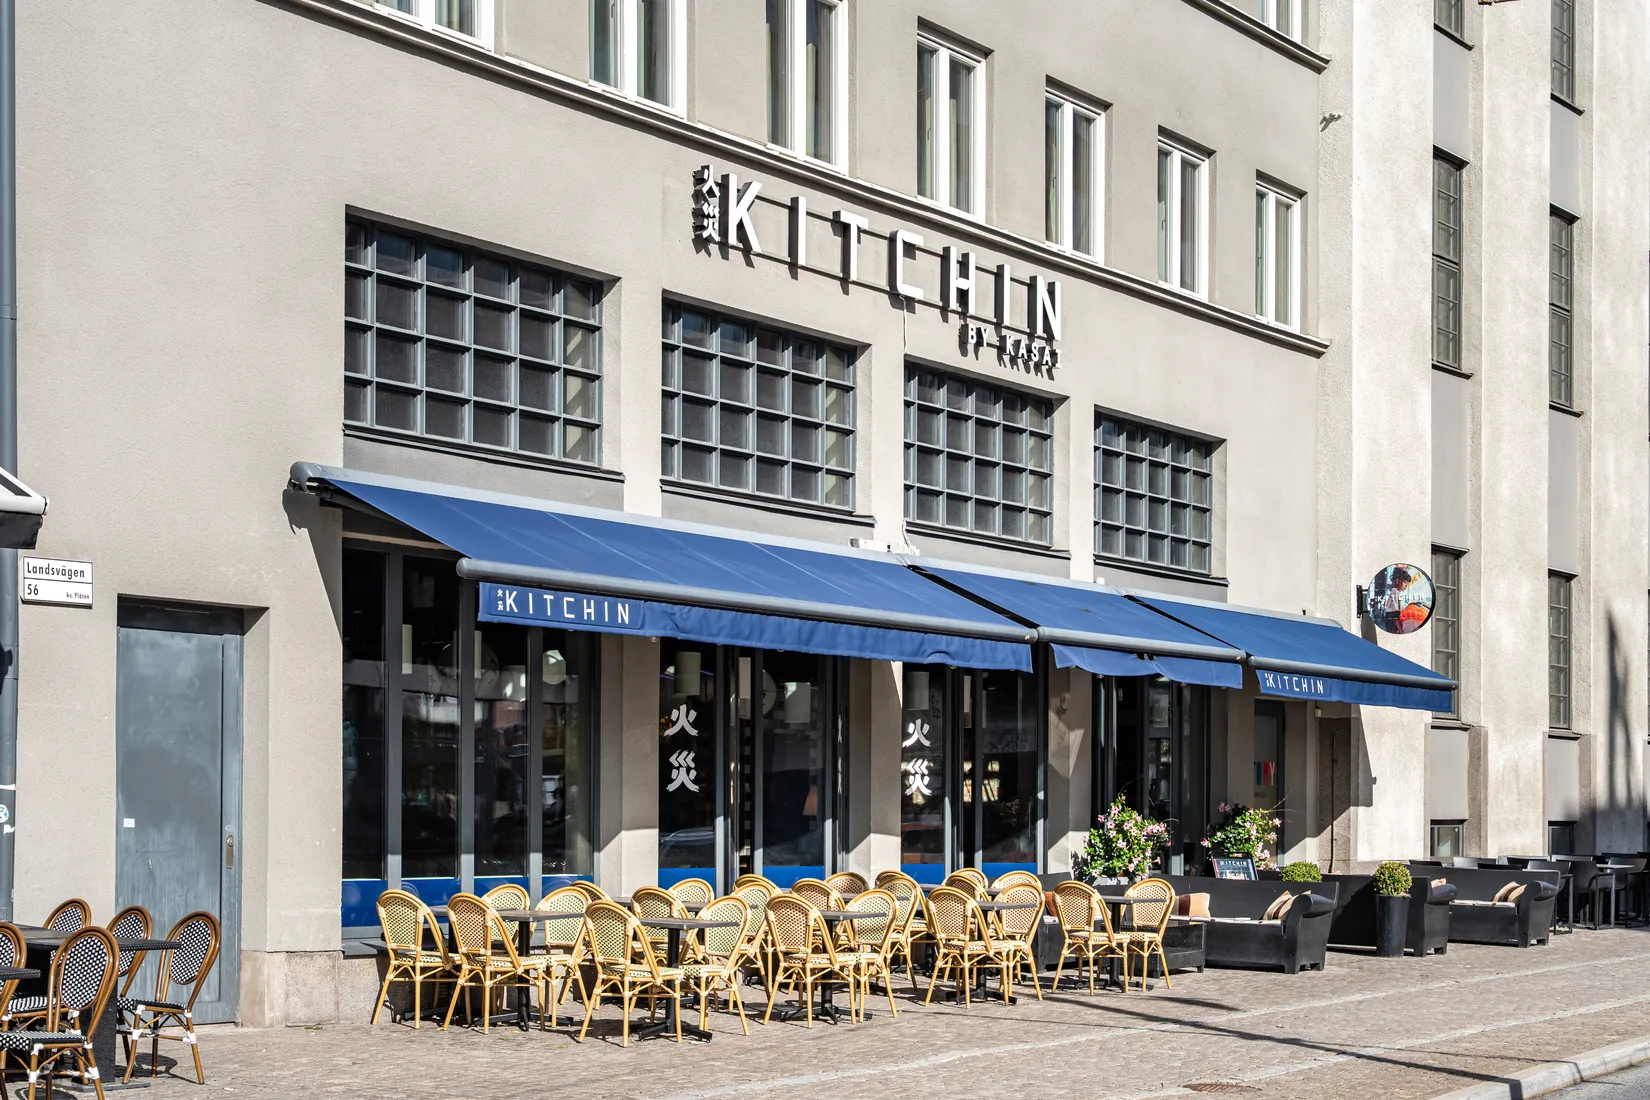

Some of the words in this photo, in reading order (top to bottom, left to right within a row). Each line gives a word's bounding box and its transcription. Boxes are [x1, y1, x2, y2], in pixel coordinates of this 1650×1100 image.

[723, 172, 1061, 341] KITCHIN
[965, 323, 989, 347] BY
[1003, 334, 1062, 369] KASAI
[27, 562, 85, 580] Landsvägen
[27, 583, 39, 596] 56
[505, 590, 629, 625] KITCHIN
[1268, 673, 1324, 694] KITCHIN
[663, 703, 700, 793] 火災
[901, 718, 933, 797] 火災
